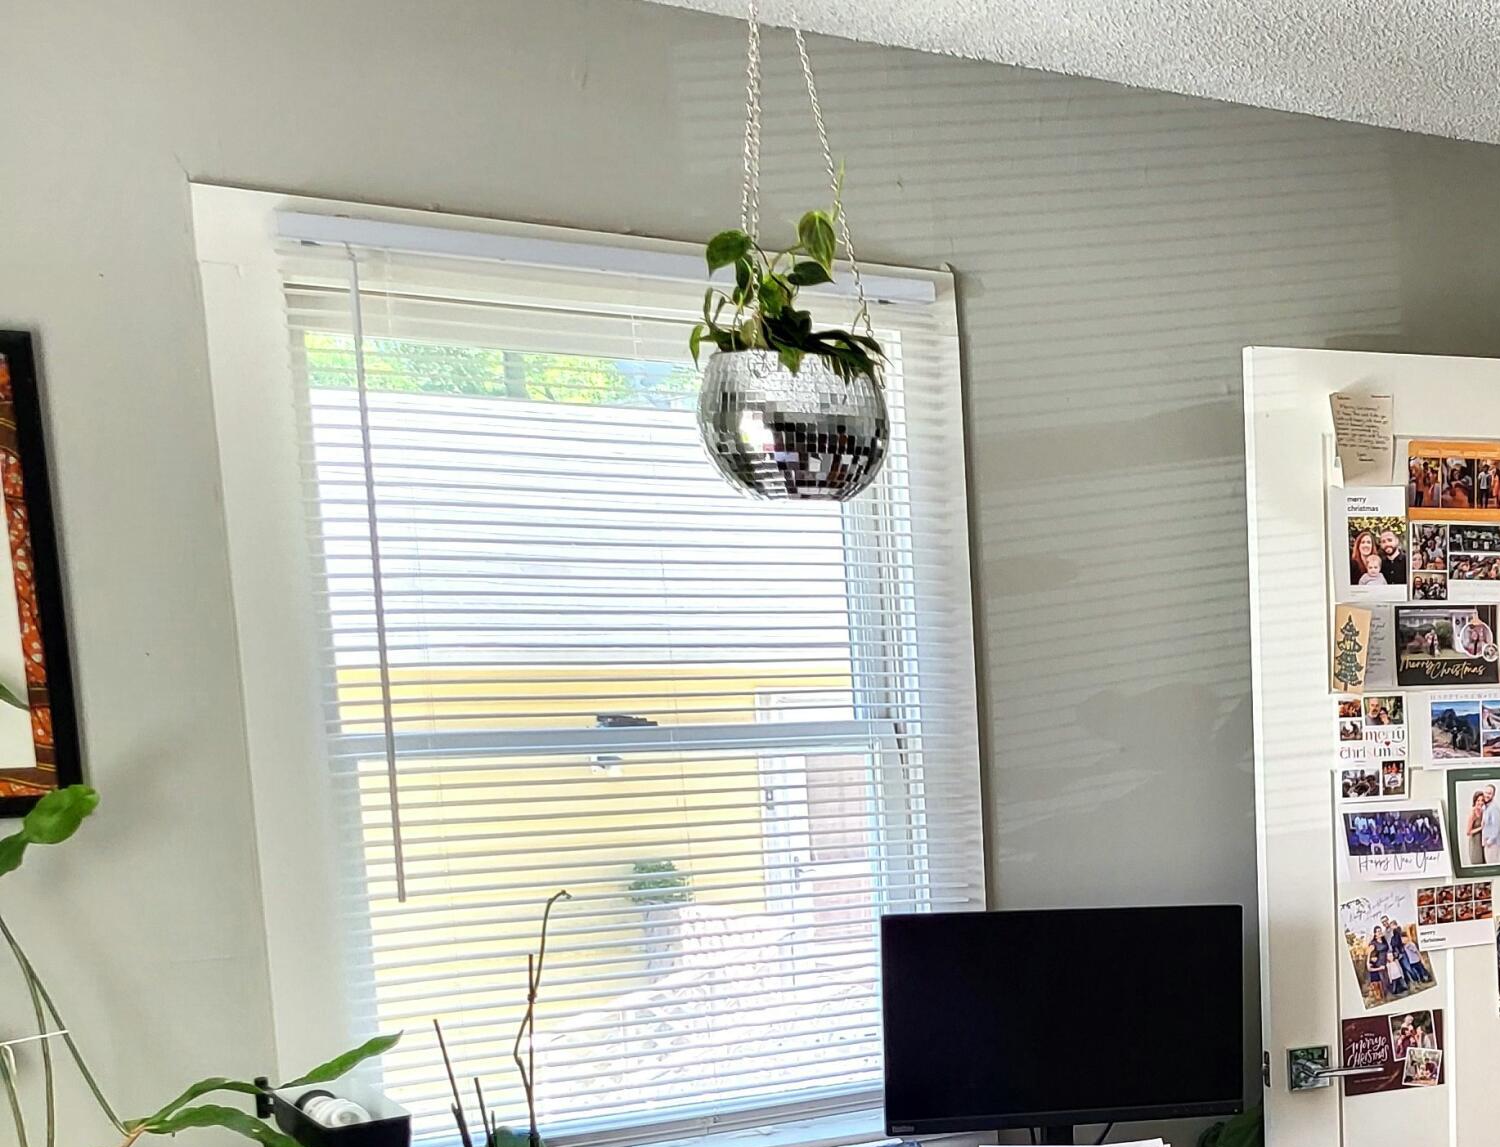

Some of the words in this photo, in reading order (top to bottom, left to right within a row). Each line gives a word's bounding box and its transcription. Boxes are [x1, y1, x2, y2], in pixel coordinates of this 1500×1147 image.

[1347, 496, 1367, 504] merry
[1430, 661, 1486, 679] Christmas
[1365, 728, 1405, 743] mery
[1340, 746, 1406, 759] chritms
[1358, 854, 1390, 873] Happy
[1393, 854, 1413, 871] New
